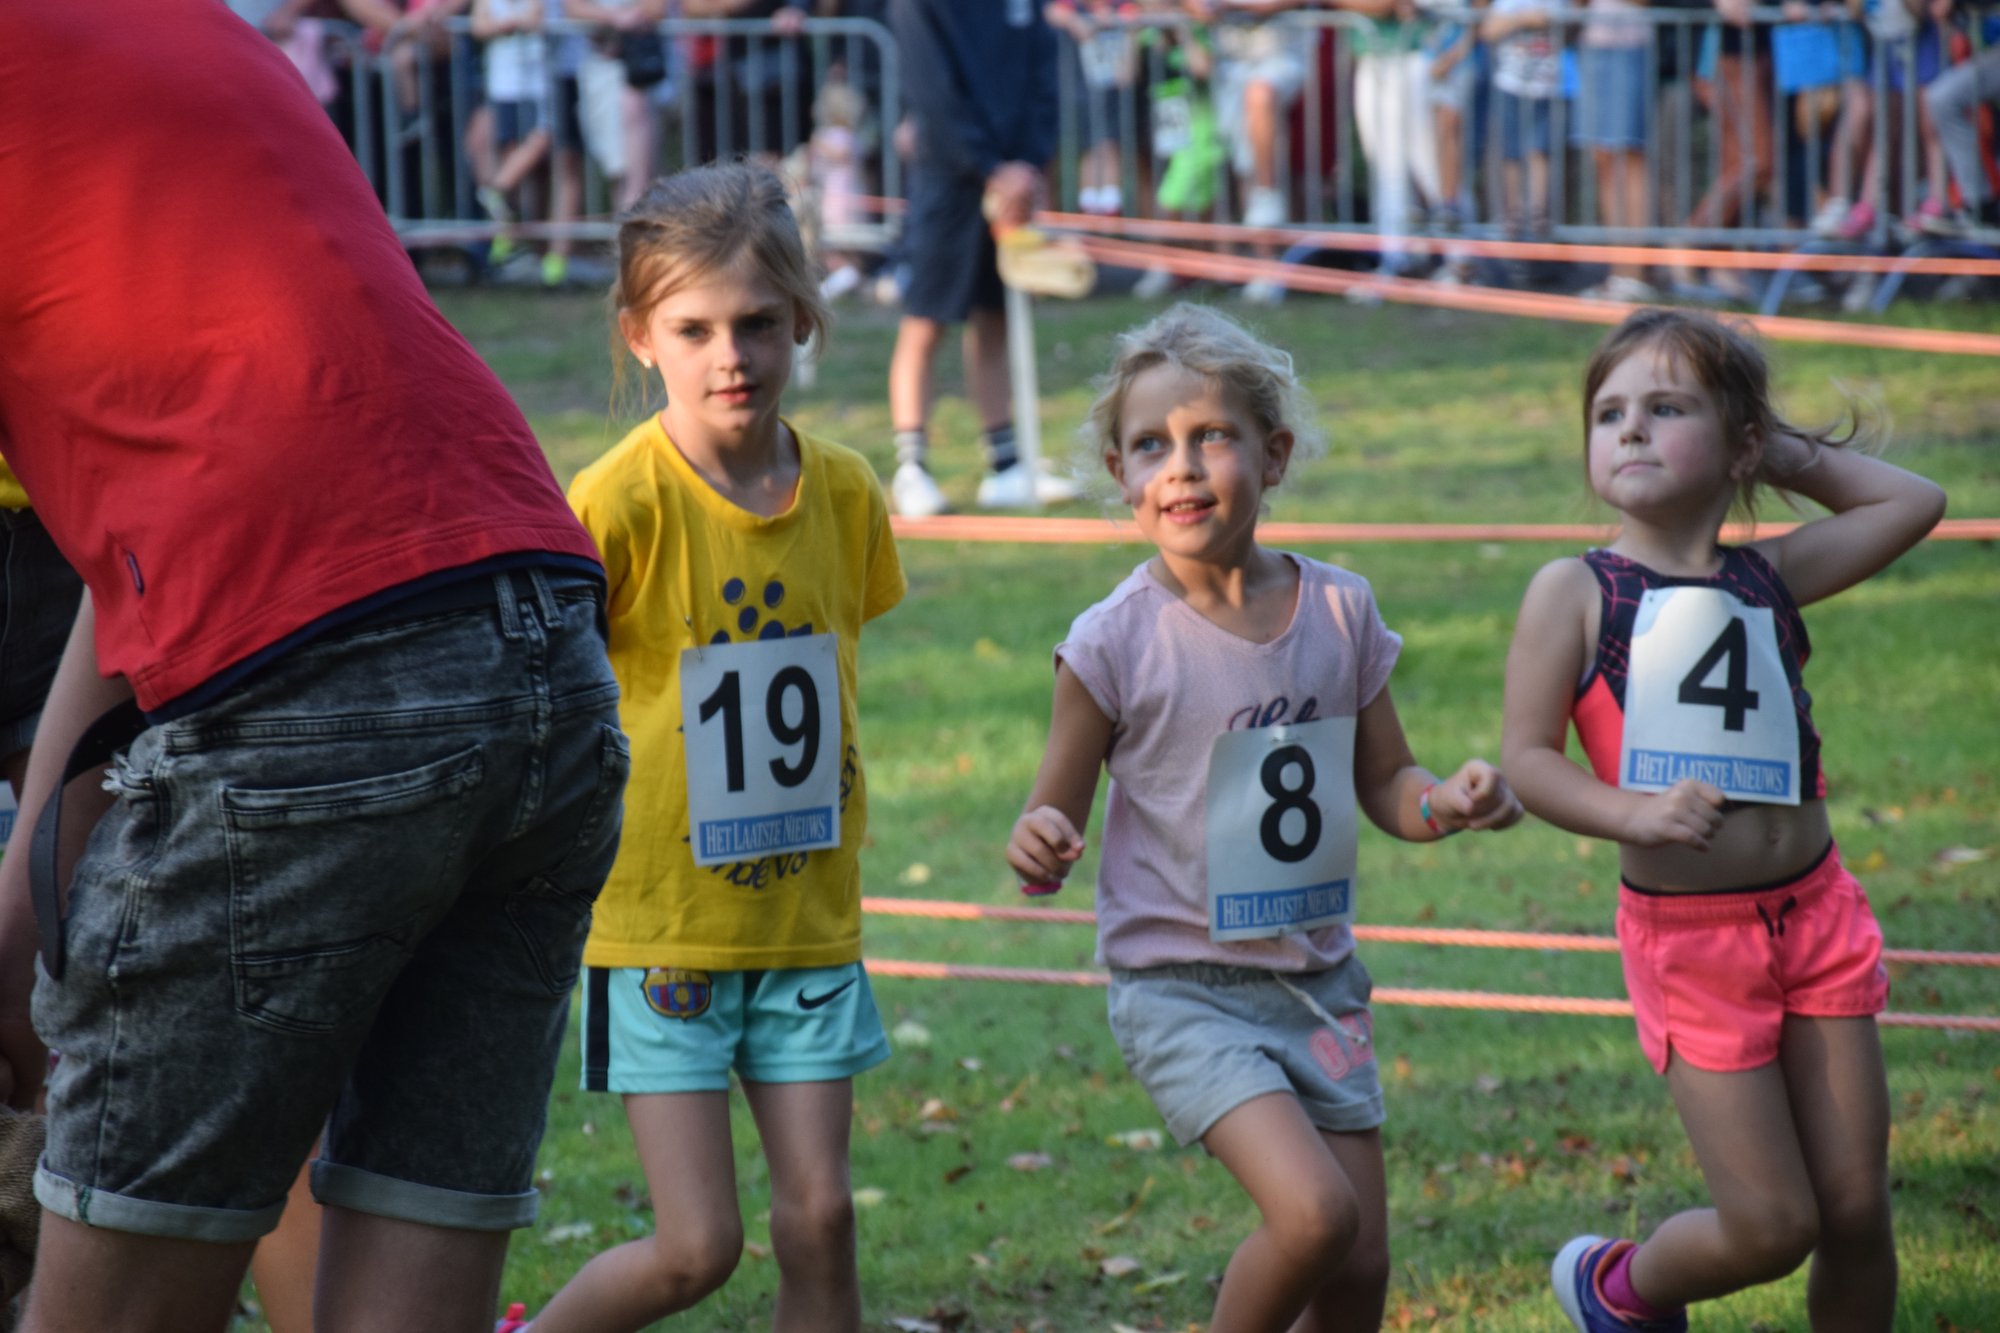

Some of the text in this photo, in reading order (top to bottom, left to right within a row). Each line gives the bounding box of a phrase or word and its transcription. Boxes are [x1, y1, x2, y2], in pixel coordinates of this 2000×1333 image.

[1678, 616, 1759, 732] 4
[699, 665, 821, 793] 19
[1260, 745, 1322, 863] 8
[1635, 752, 1666, 783] HET
[1732, 759, 1785, 793] NIEUWS
[705, 813, 827, 855] HET LAATSTE NIEUWS
[1222, 897, 1250, 927] HET
